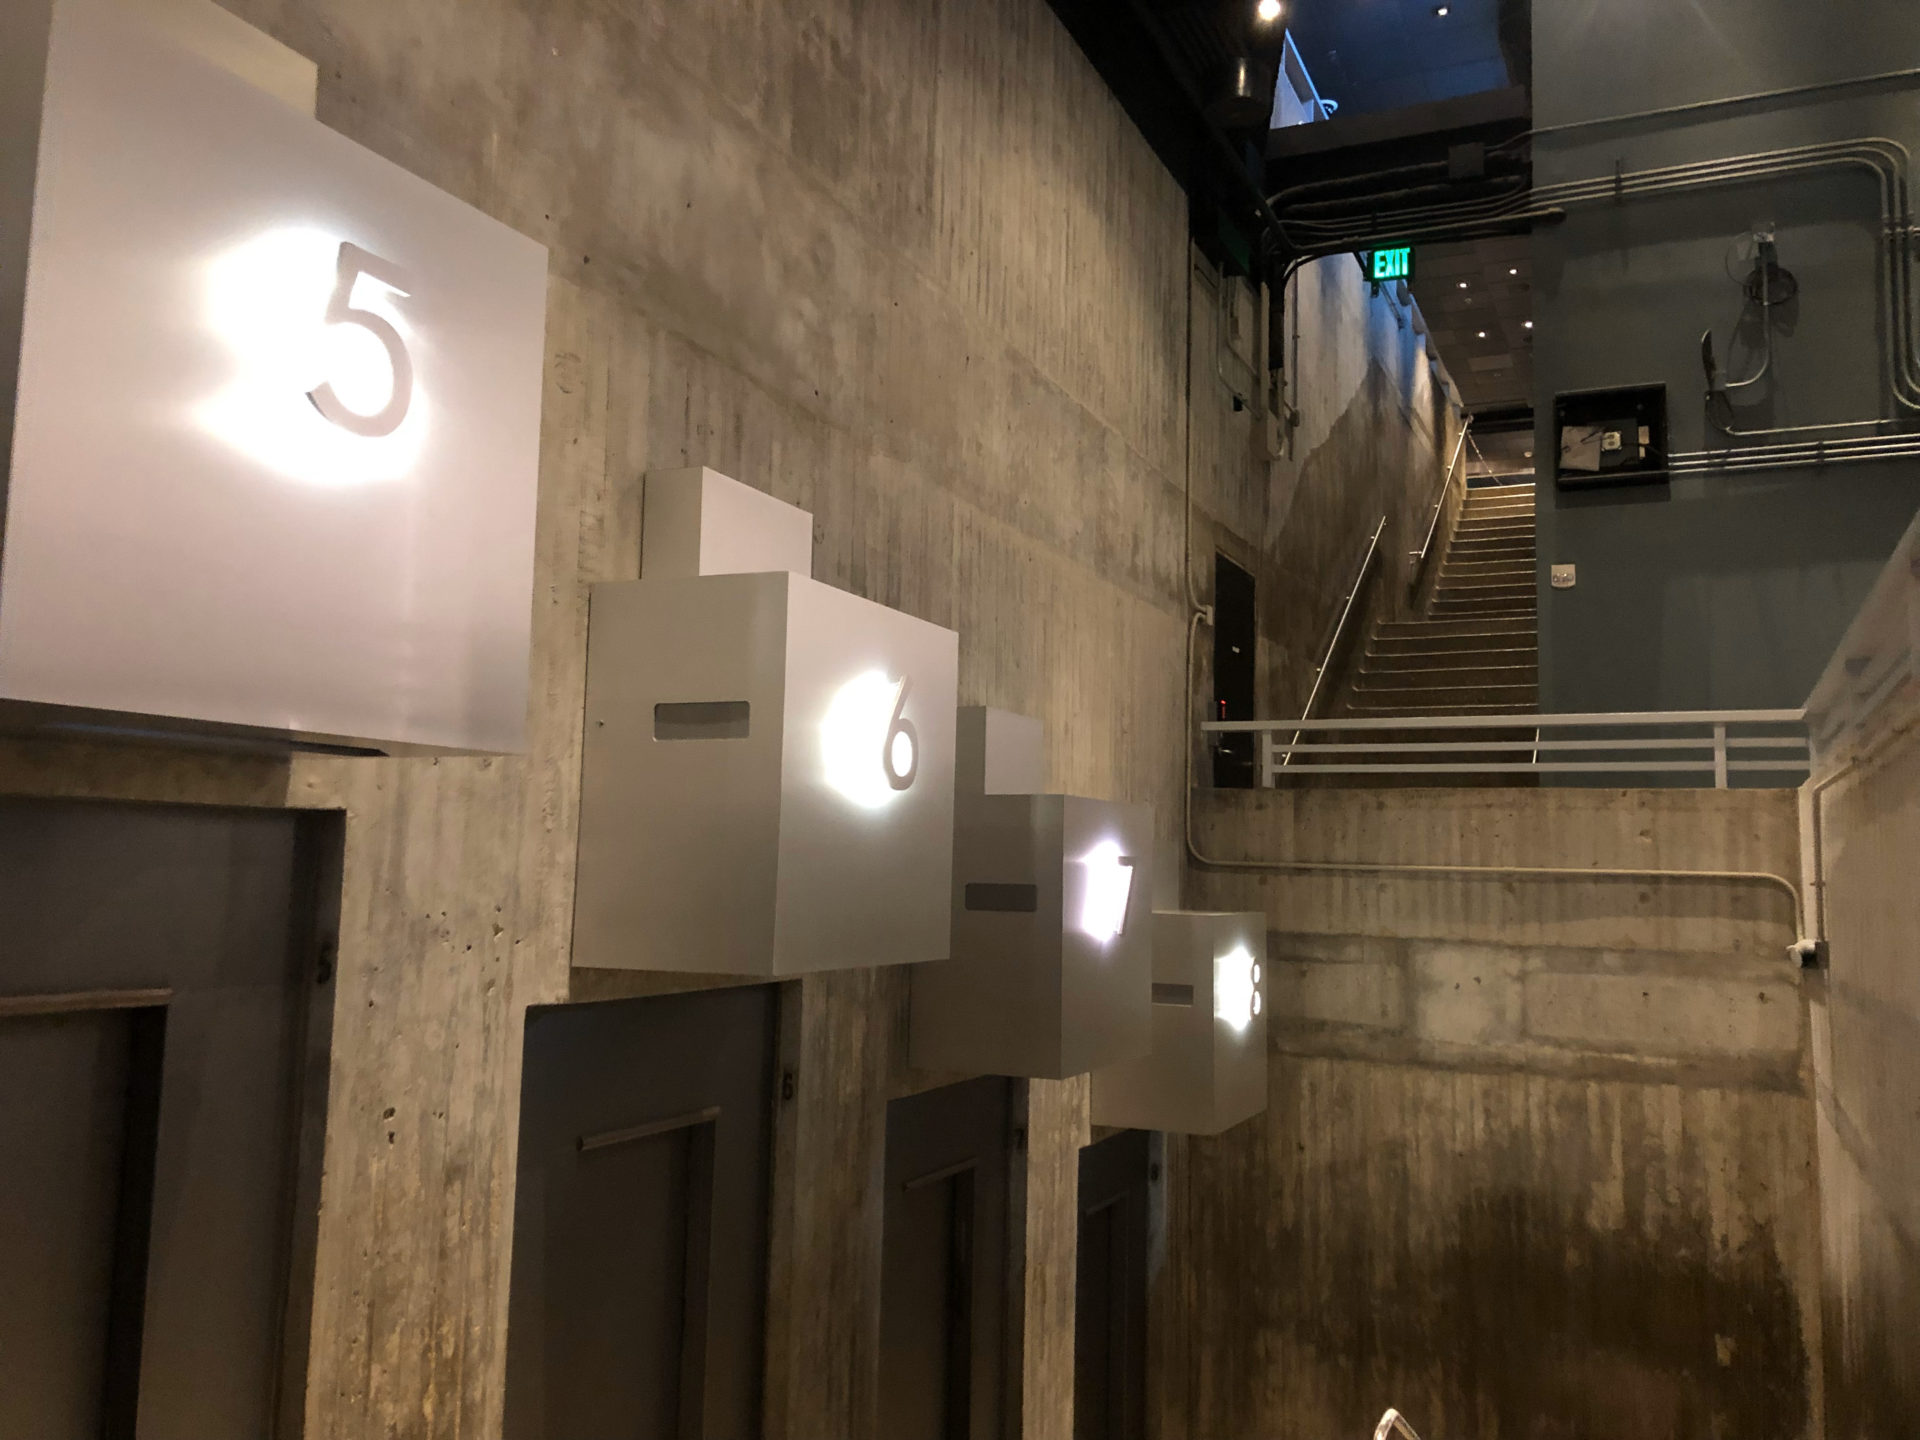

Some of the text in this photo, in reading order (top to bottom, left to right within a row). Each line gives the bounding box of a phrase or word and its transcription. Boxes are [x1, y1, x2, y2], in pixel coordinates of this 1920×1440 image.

[1374, 247, 1411, 279] EXIT
[304, 240, 414, 438] 5
[882, 672, 919, 791] 6
[1249, 956, 1264, 1022] 8
[782, 1073, 794, 1100] 6
